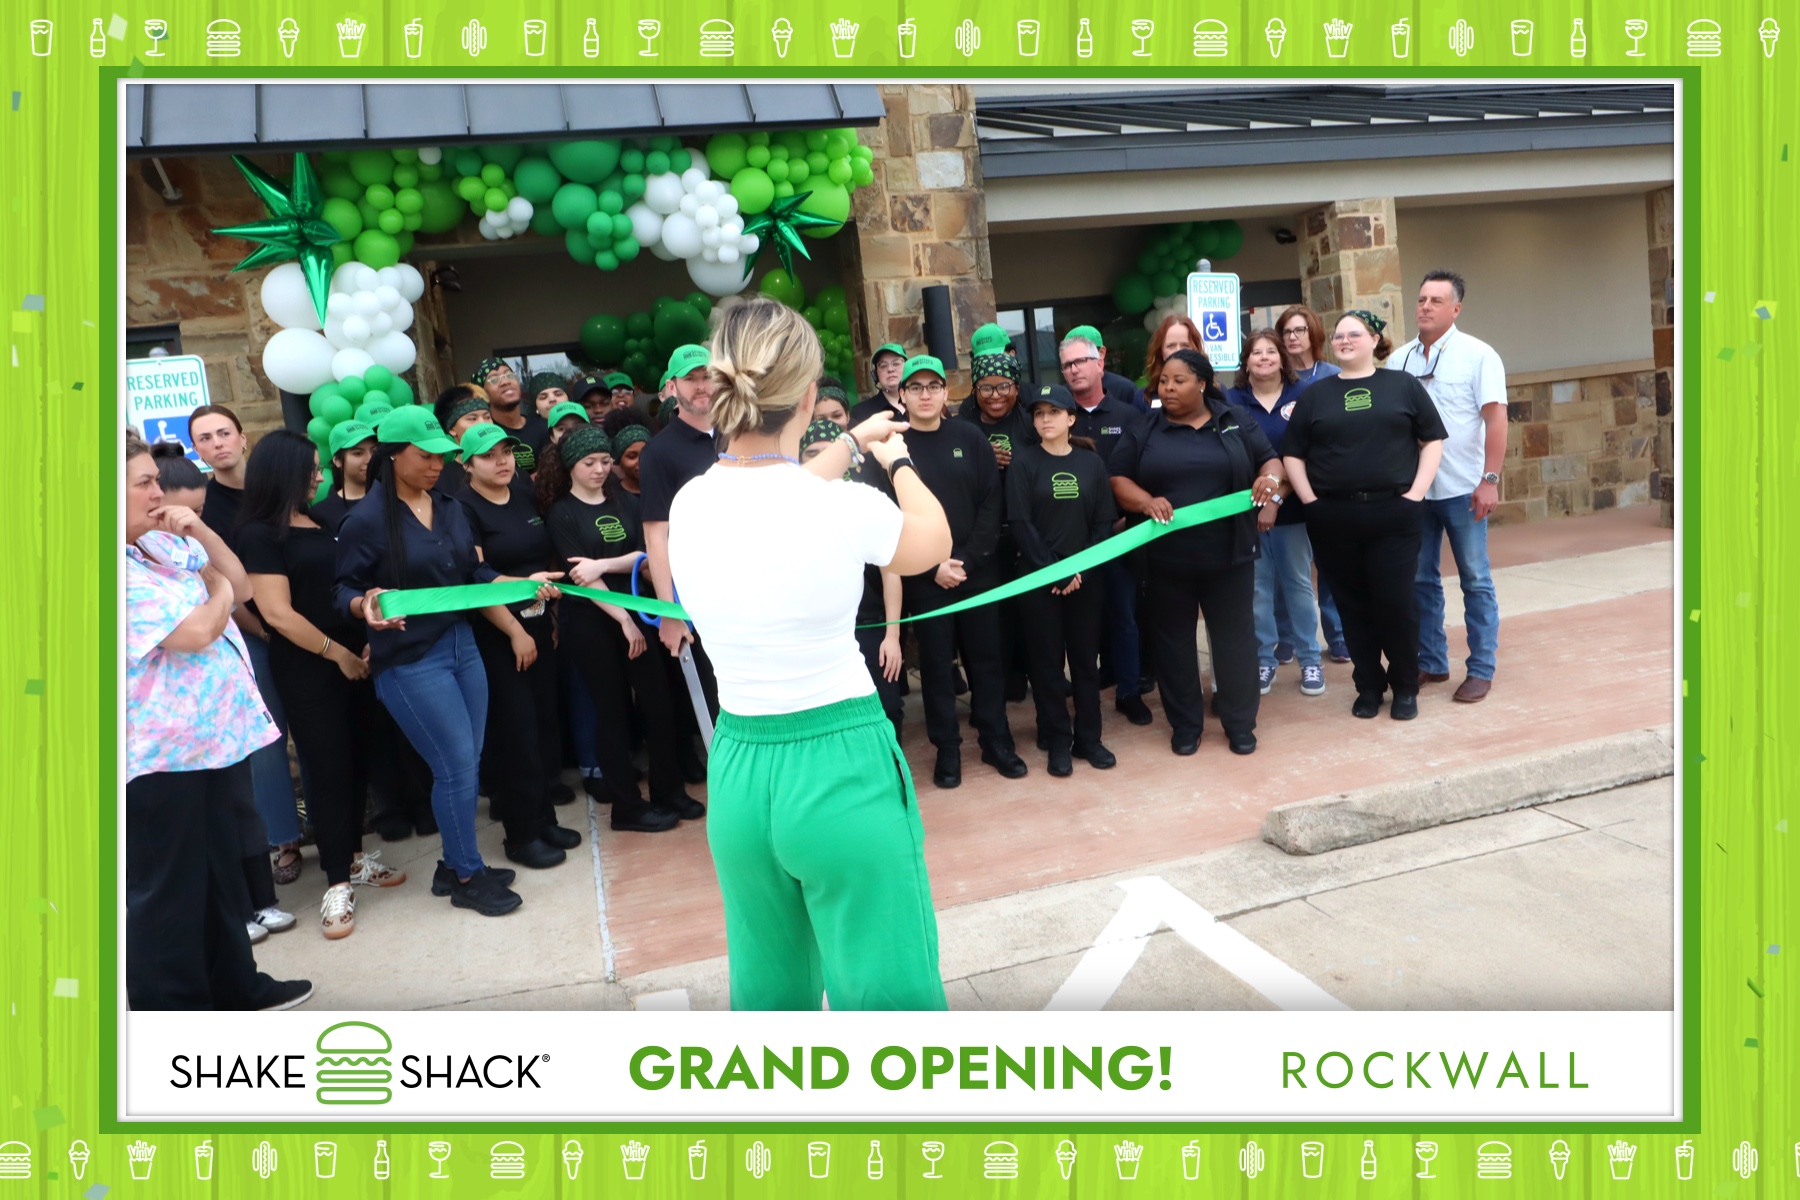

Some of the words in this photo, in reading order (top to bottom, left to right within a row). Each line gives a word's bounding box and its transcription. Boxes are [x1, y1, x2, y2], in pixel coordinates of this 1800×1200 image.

[1193, 280, 1234, 294] RESERVED
[1198, 297, 1230, 309] PARKING
[1210, 344, 1222, 352] VAN
[1209, 353, 1235, 362] ESSIBLE
[126, 371, 200, 391] RESERVED
[134, 392, 198, 411] PARKING
